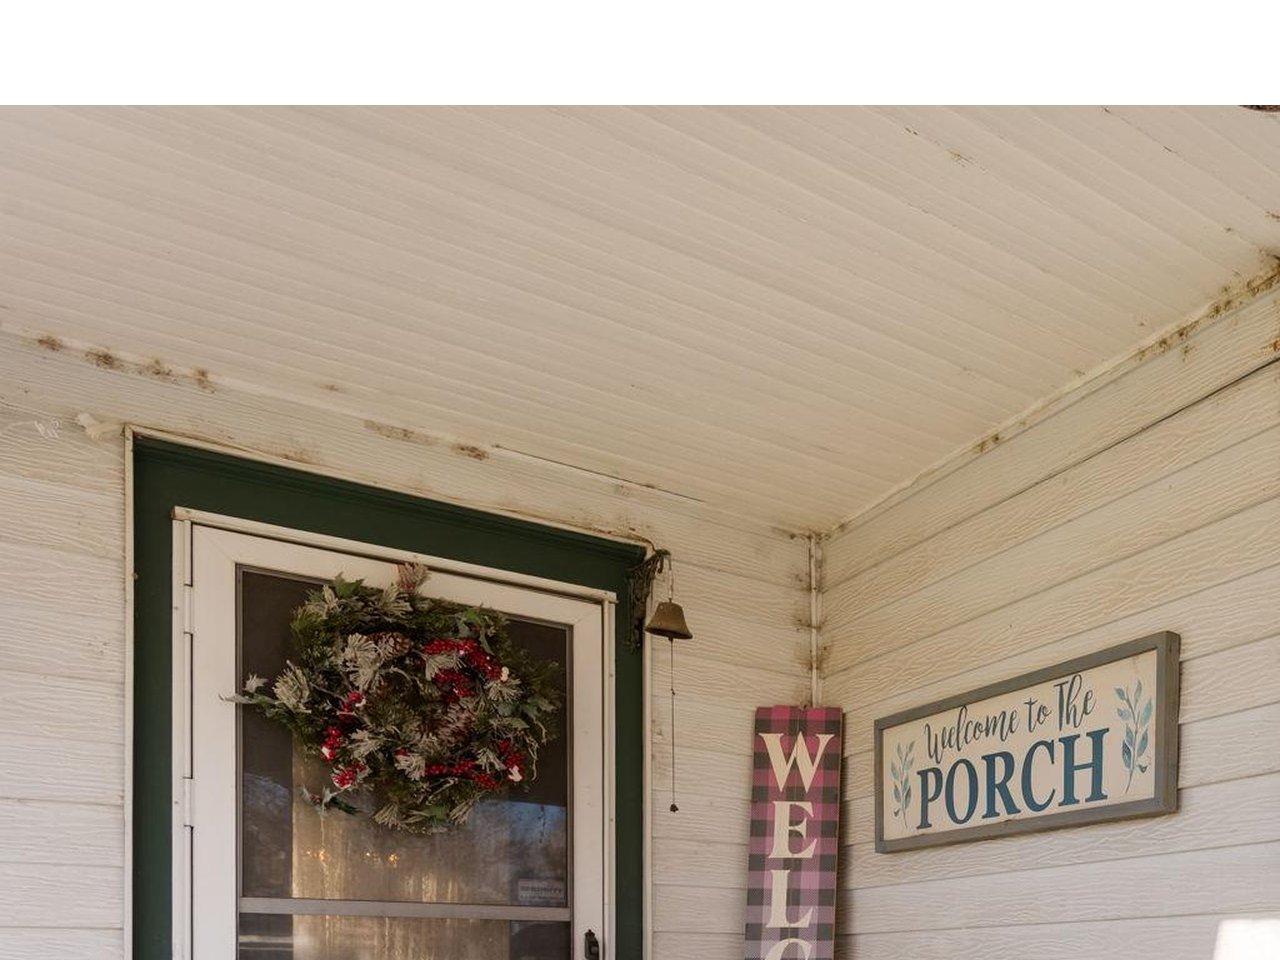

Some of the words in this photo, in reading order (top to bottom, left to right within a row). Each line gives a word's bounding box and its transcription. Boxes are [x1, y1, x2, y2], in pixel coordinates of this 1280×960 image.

[924, 705, 1018, 764] Welcome
[1024, 697, 1051, 732] to
[1053, 673, 1097, 731] The
[916, 728, 1109, 829] PORCH
